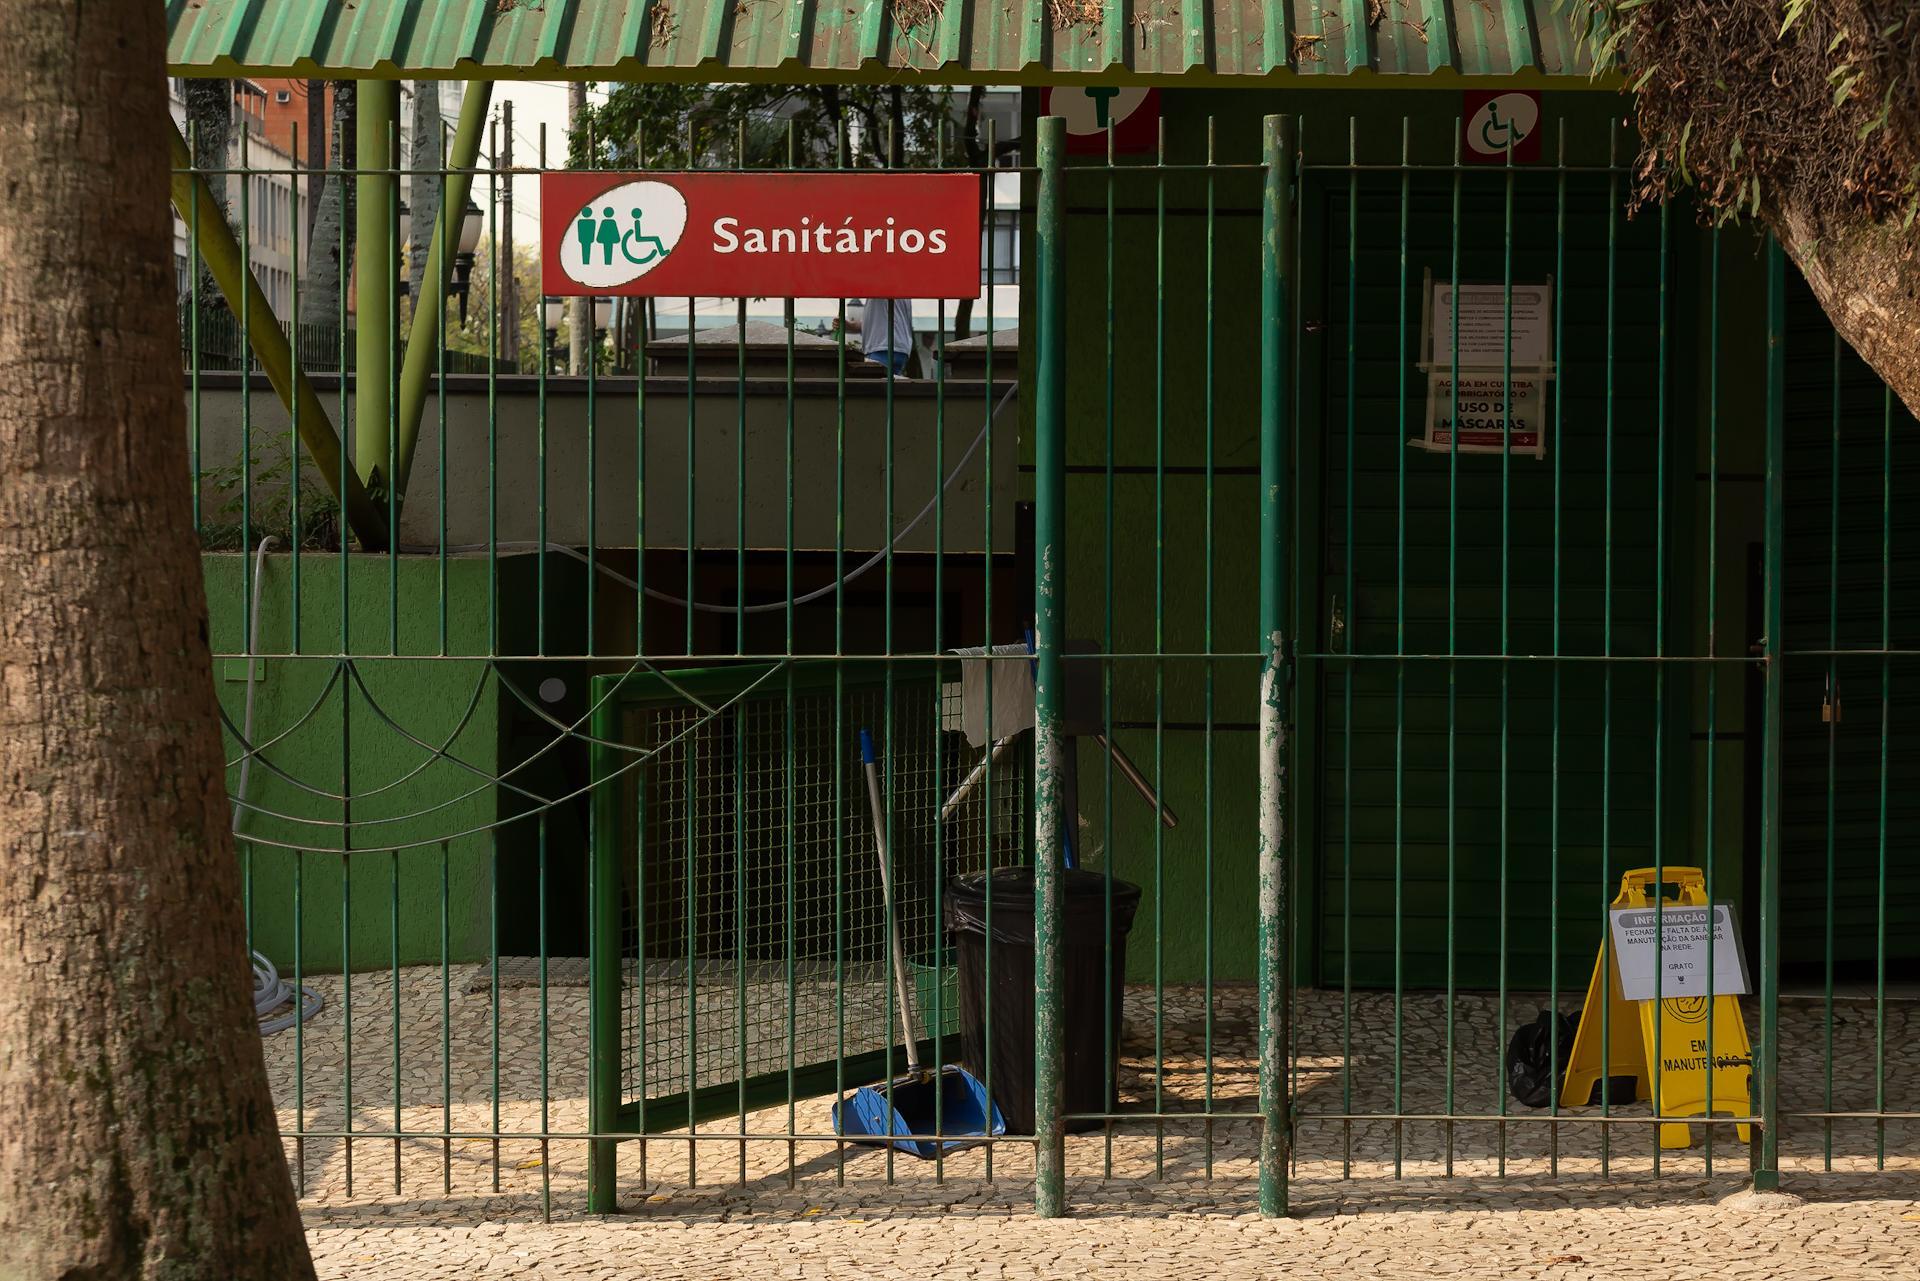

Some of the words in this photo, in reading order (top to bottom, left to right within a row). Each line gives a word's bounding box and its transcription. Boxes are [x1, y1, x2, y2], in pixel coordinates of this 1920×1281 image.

[713, 216, 948, 254] Sanitários
[1438, 380, 1472, 388] AGRA
[1473, 380, 1488, 388] EM
[1489, 380, 1534, 389] CUTIBA
[1458, 402, 1490, 413] USO
[1441, 415, 1526, 430] MÁSCARAS
[1666, 926, 1689, 935] FALTA
[1627, 935, 1677, 945] MANUTEÇÃO
[1679, 934, 1689, 942] DA
[1690, 934, 1724, 942] SANEAR
[1690, 1040, 1708, 1052] EM
